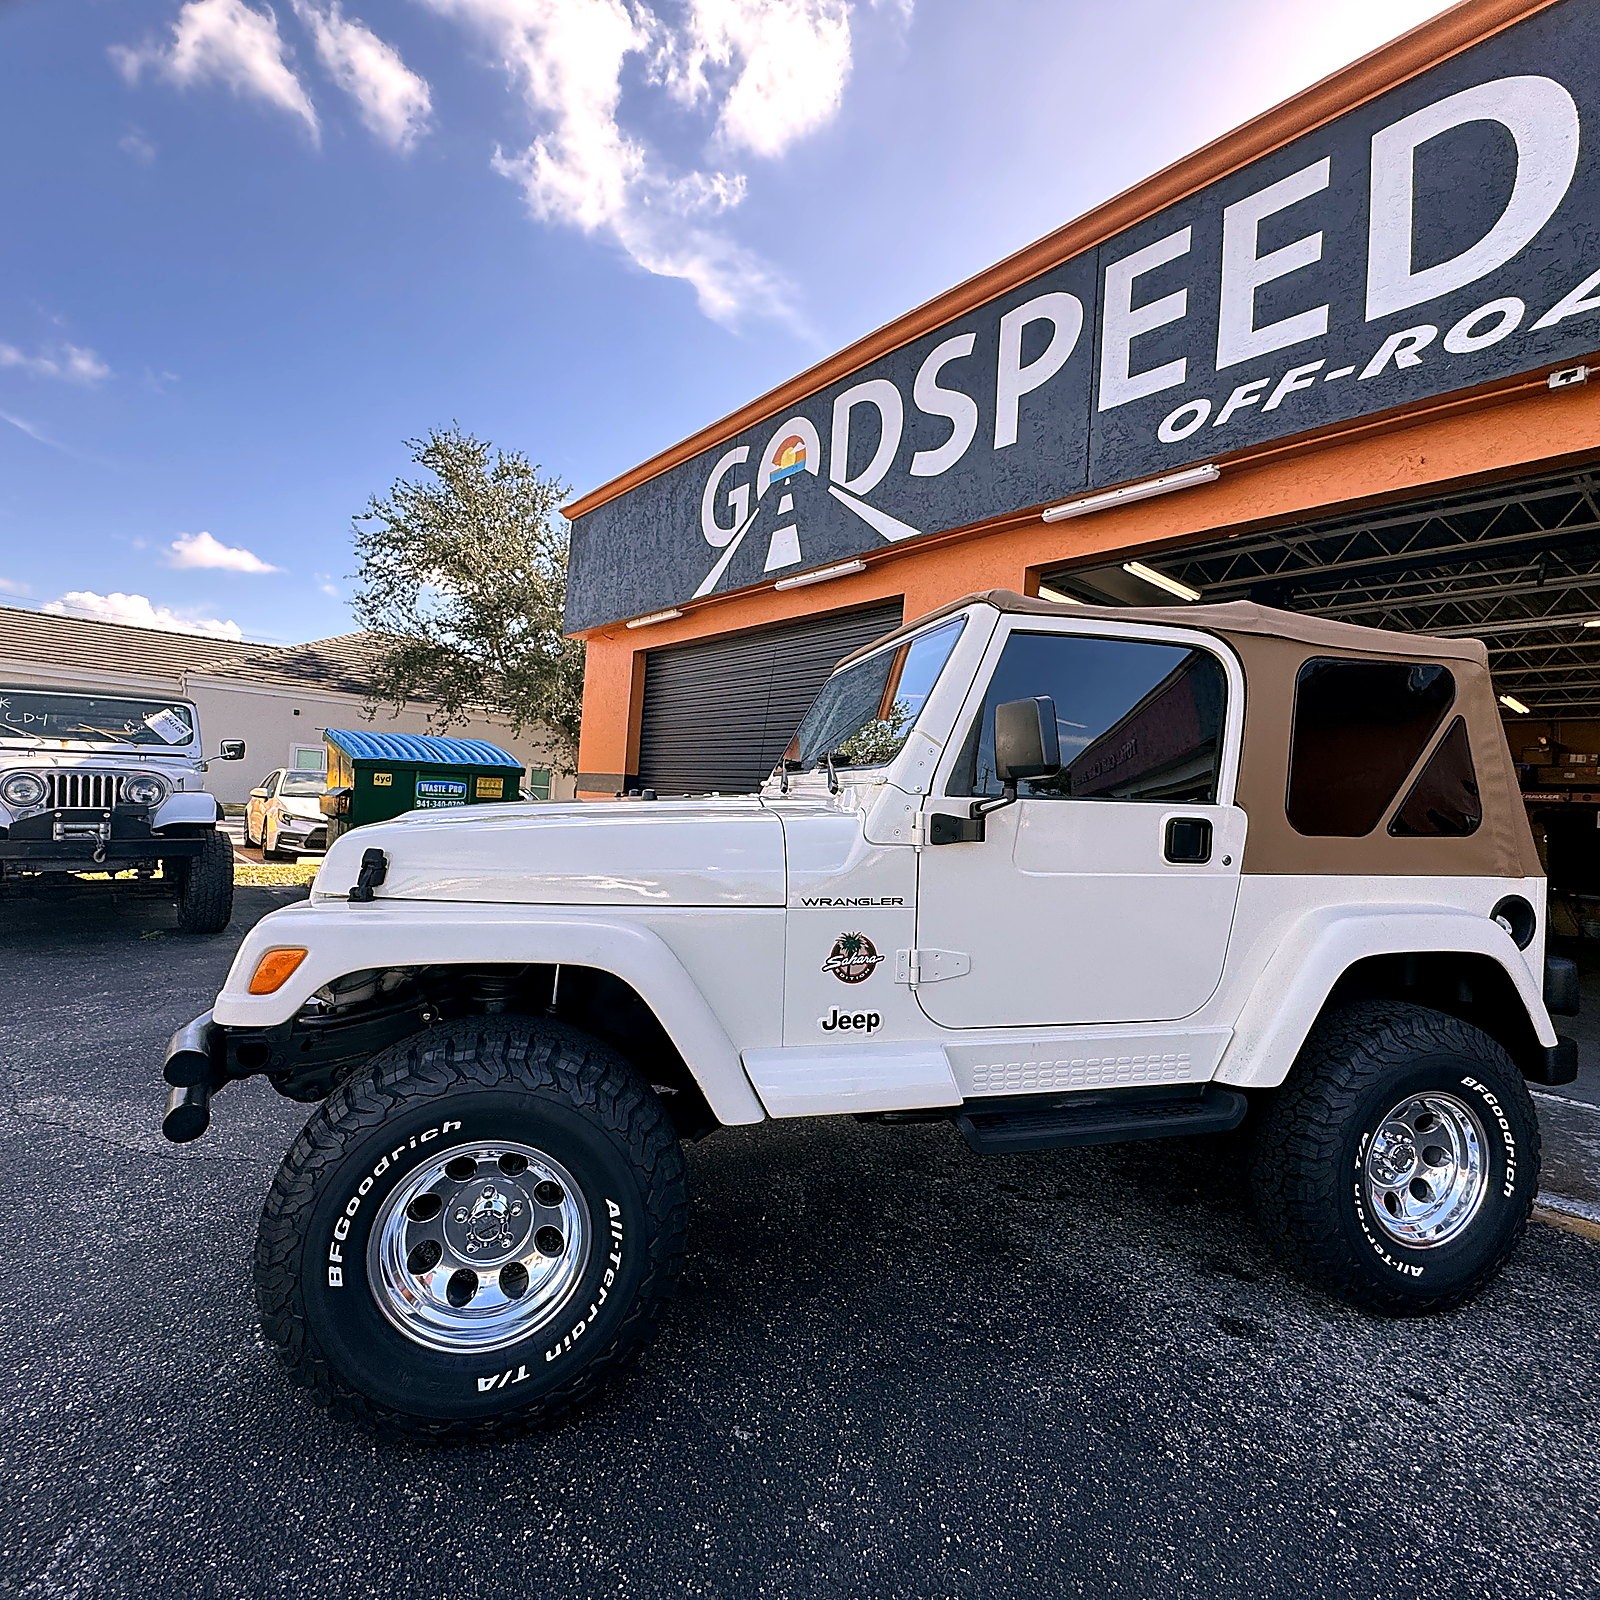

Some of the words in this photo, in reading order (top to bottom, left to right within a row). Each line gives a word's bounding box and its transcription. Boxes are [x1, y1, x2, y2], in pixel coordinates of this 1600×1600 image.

[701, 75, 1580, 548] GODSPEED
[374, 775, 391, 784] 4yd
[421, 783, 446, 793] WASTE
[448, 784, 463, 794] PRO
[801, 897, 904, 907] WRANGLER
[822, 952, 884, 972] Sahara
[834, 967, 871, 981] EDITION
[822, 1009, 880, 1033] Jeep
[1460, 1076, 1517, 1198] BFGoodrich
[328, 1121, 462, 1287] BFGoodrich
[1354, 1183, 1424, 1277] All-Terrain
[545, 1198, 623, 1362] All-Terrain
[477, 1364, 531, 1392] T/A
